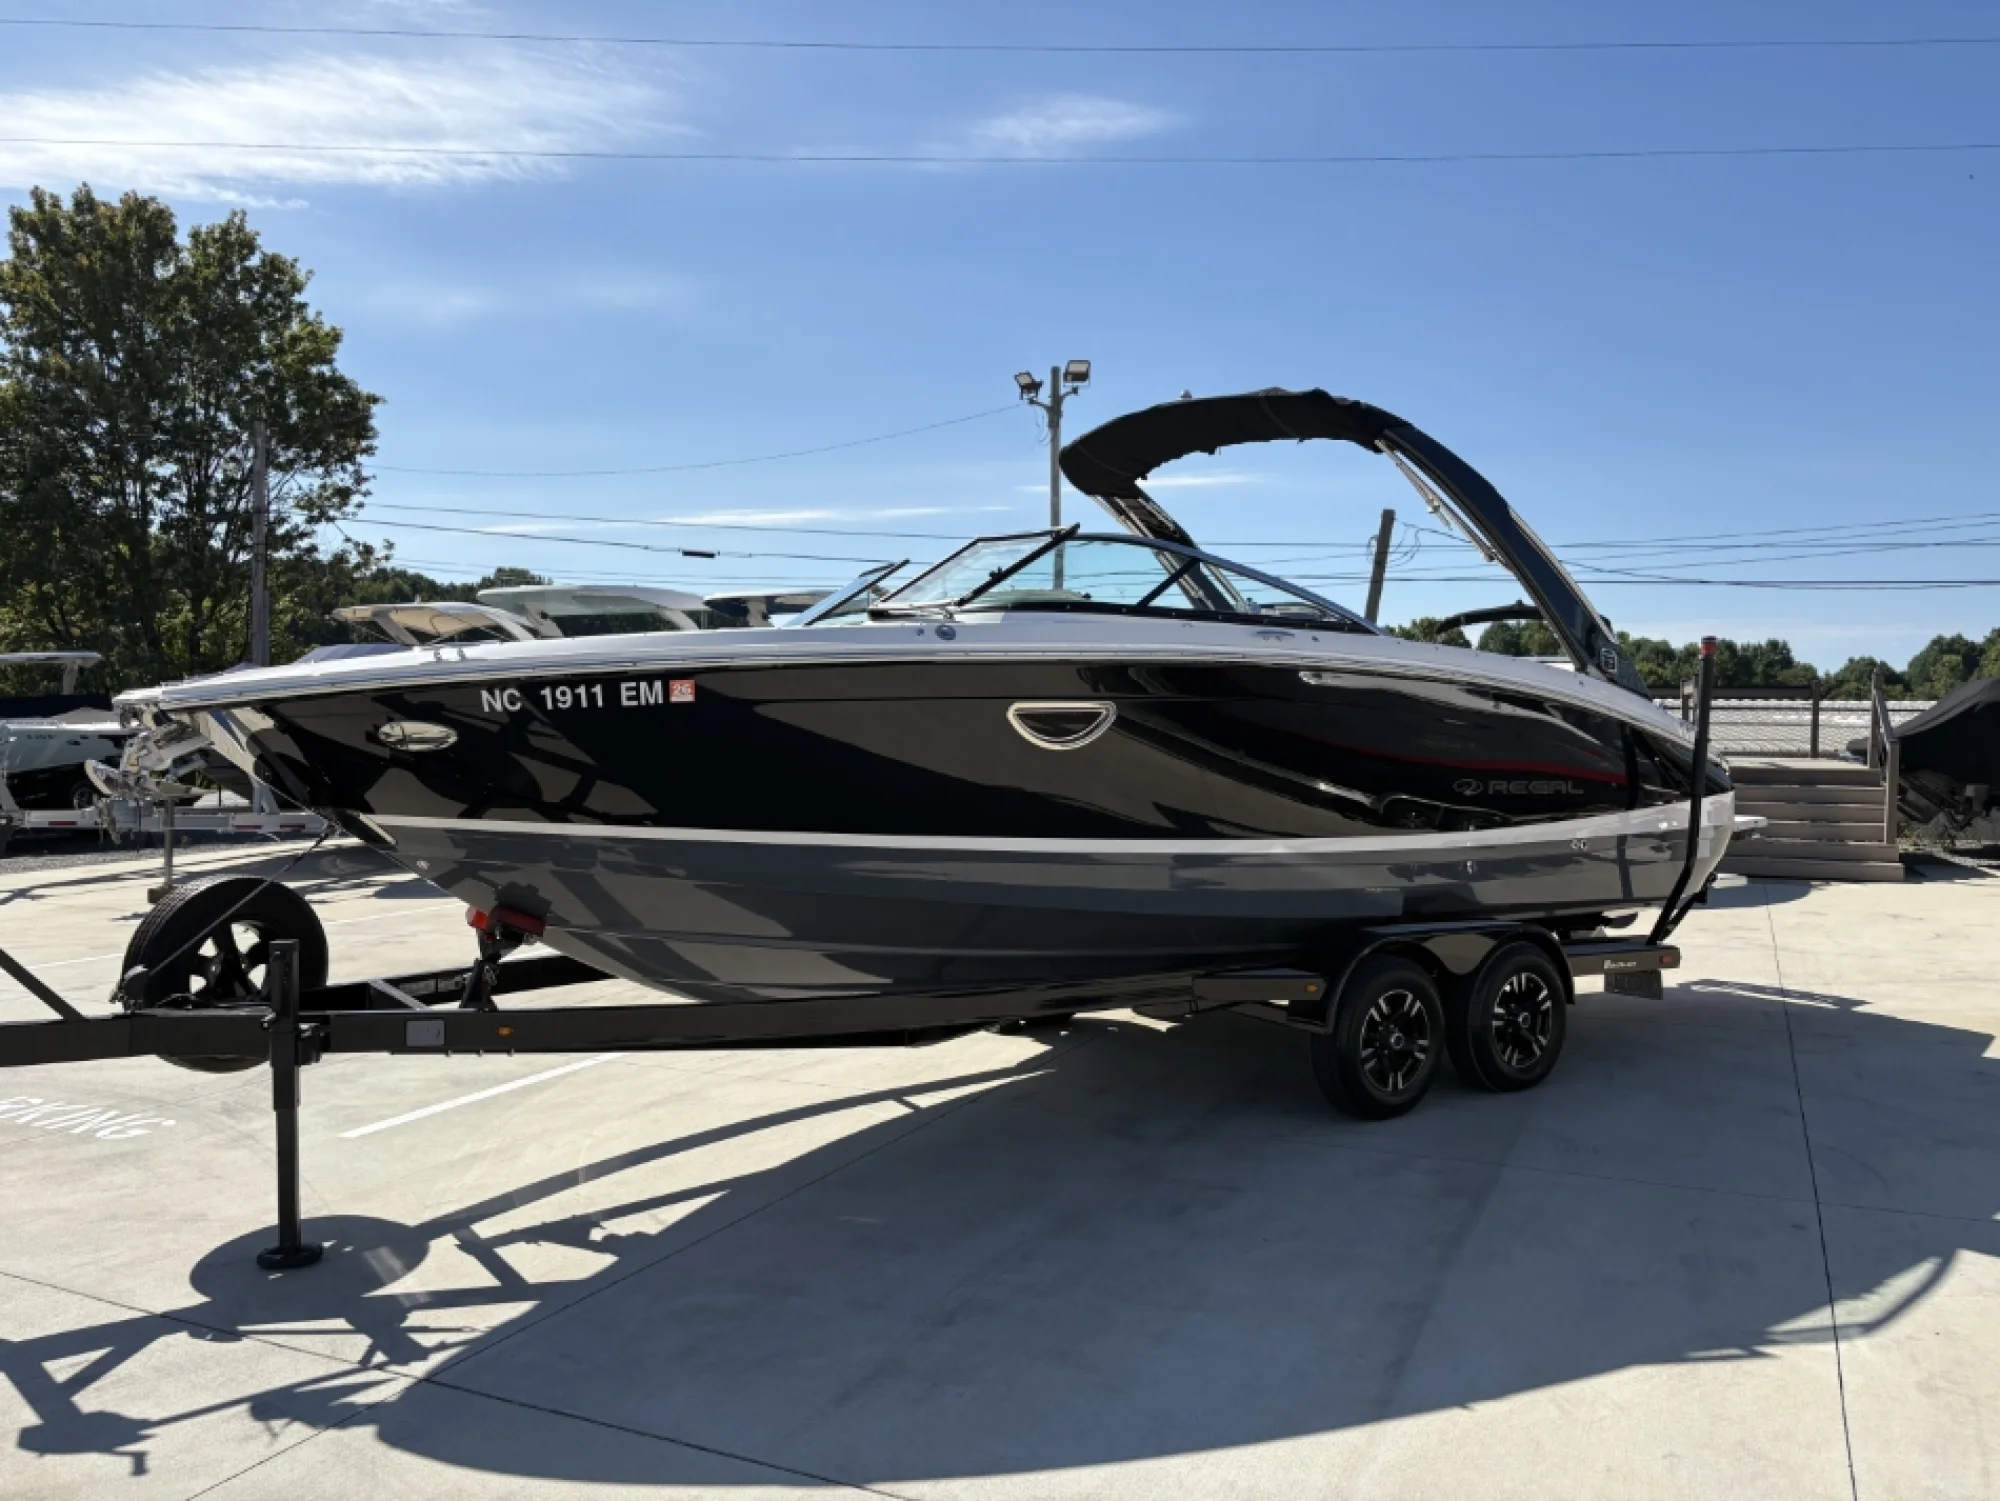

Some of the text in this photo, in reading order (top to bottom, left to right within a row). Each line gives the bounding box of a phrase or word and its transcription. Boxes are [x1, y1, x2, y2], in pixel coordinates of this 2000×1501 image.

[480, 680, 664, 712] NC 1911 EM
[1487, 780, 1584, 795] REGAL
